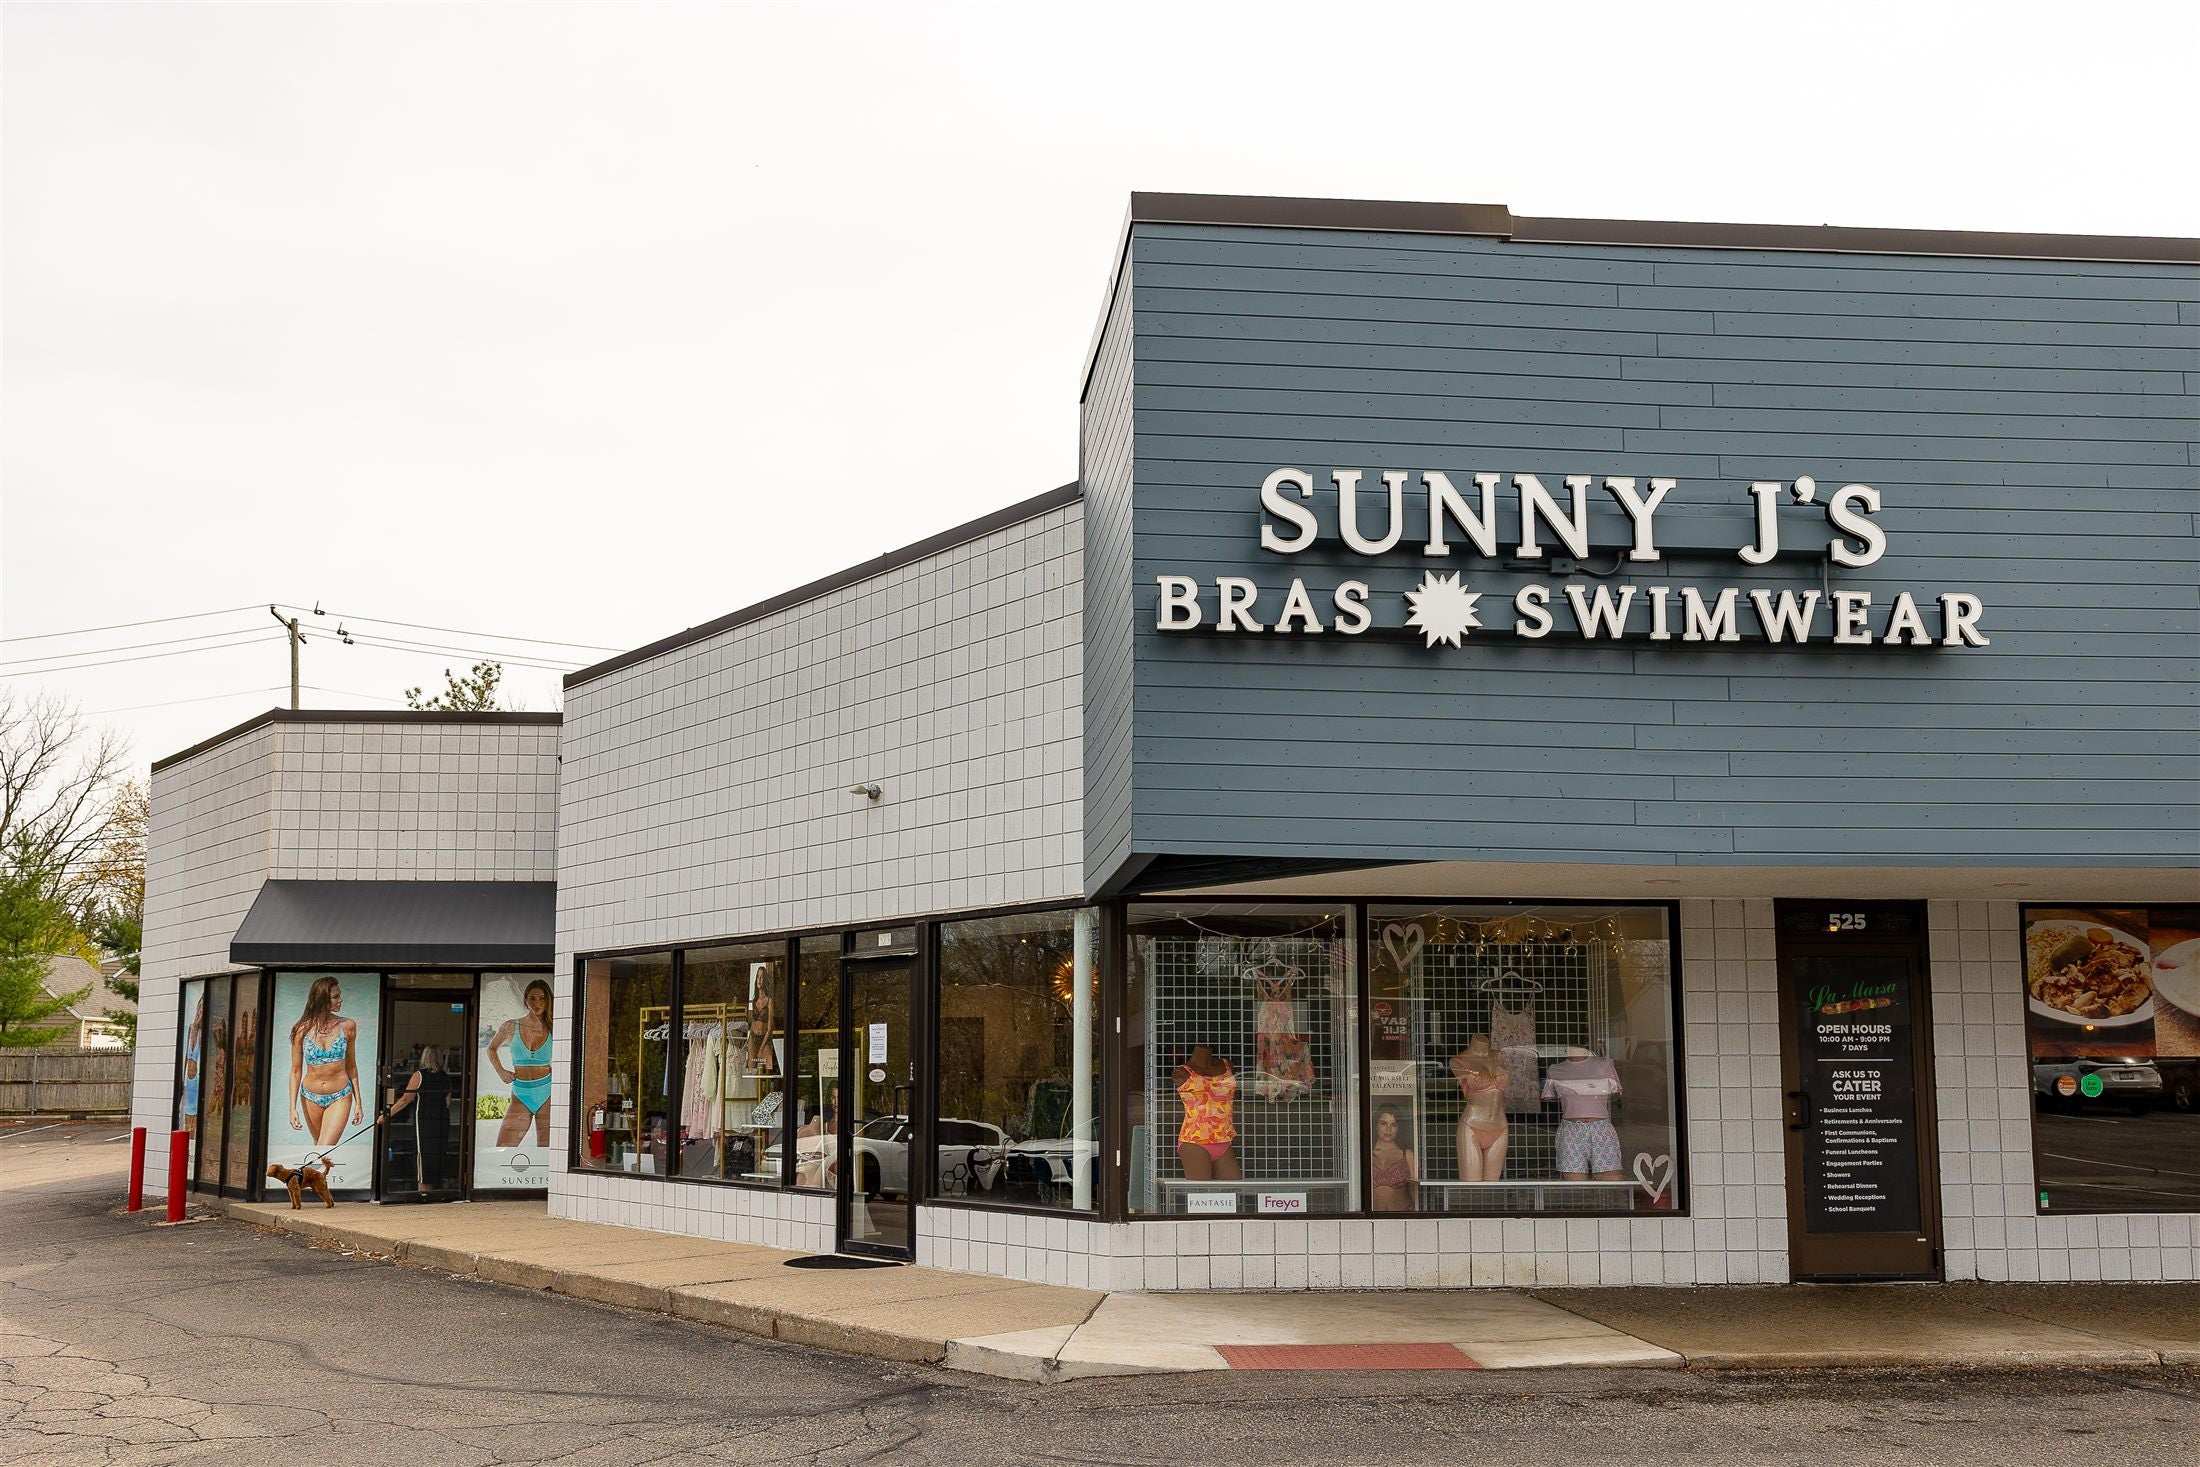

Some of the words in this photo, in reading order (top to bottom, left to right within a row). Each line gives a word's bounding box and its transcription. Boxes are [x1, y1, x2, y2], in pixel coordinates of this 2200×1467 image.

[1259, 467, 1677, 561] SUNNY
[1737, 475, 1887, 569] J'S
[1156, 574, 1373, 635] BRAS
[1514, 584, 1991, 648] SWIMWEAR
[1829, 913, 1867, 930] 525
[1808, 984, 1836, 1014] La
[1816, 1024, 1849, 1034] OPEN
[1851, 1024, 1892, 1034] HOURS
[1832, 1080, 1882, 1092] CATER
[1264, 1196, 1300, 1212] Freya
